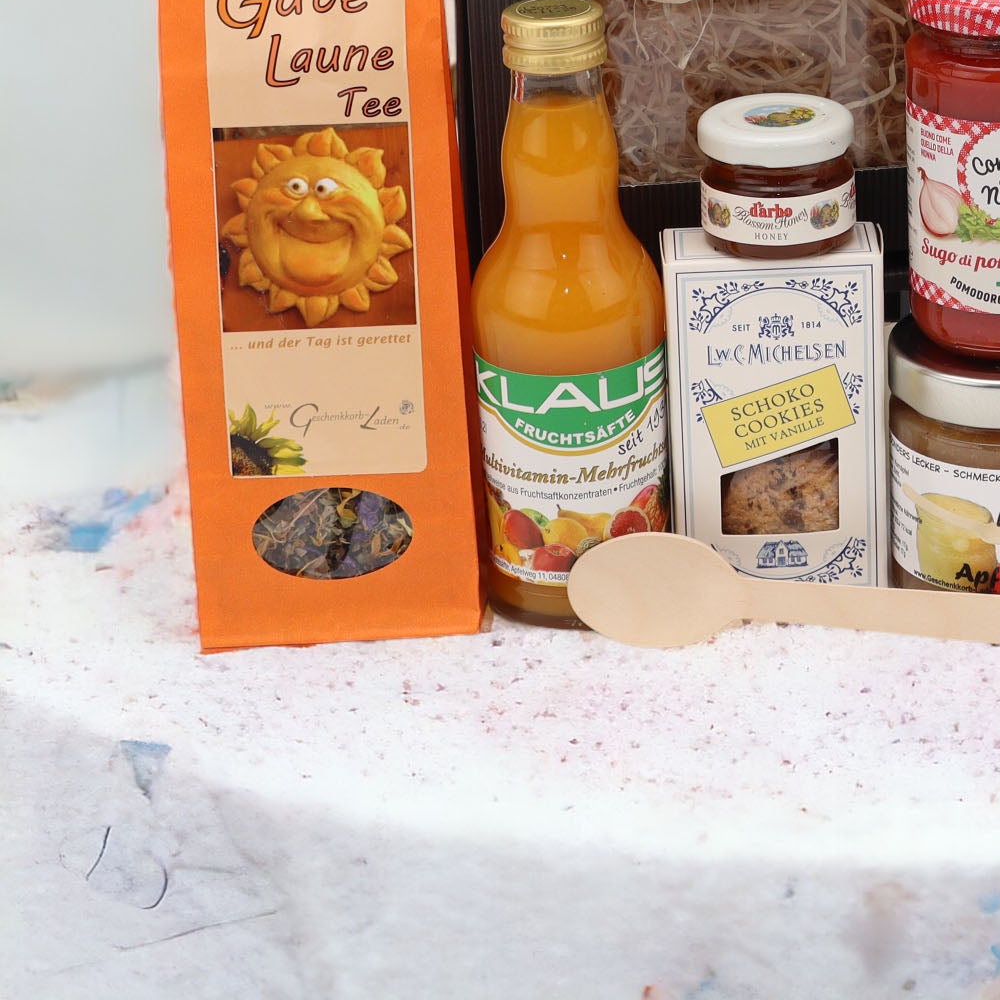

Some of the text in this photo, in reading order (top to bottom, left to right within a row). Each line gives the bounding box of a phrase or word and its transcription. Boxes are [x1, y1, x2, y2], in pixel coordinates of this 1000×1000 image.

[264, 33, 394, 88] Laune
[337, 86, 402, 118] Tee
[936, 134, 951, 146] COME
[732, 206, 774, 230] Blossom
[774, 208, 809, 230] Honey
[754, 232, 789, 241] HONEY
[921, 237, 958, 266] Sugo
[959, 254, 973, 267] di
[732, 320, 822, 333] SEIT 1814
[248, 337, 274, 350] und
[278, 337, 302, 348] der
[306, 336, 332, 349] Tag
[336, 335, 353, 346] ist
[357, 333, 412, 348] gerettet
[748, 340, 847, 364] MICHELSEN
[474, 352, 666, 414] KLAUS
[731, 383, 815, 422] SCHOKO
[514, 408, 636, 446] FRUCHTSÄFTE
[734, 398, 825, 439] COOKIES
[618, 429, 644, 455] seit
[744, 416, 825, 451] MIT VANILLE
[911, 455, 940, 473] LECKER
[507, 484, 519, 495] aus
[520, 487, 613, 501] Fruchtsaftkonzentraten
